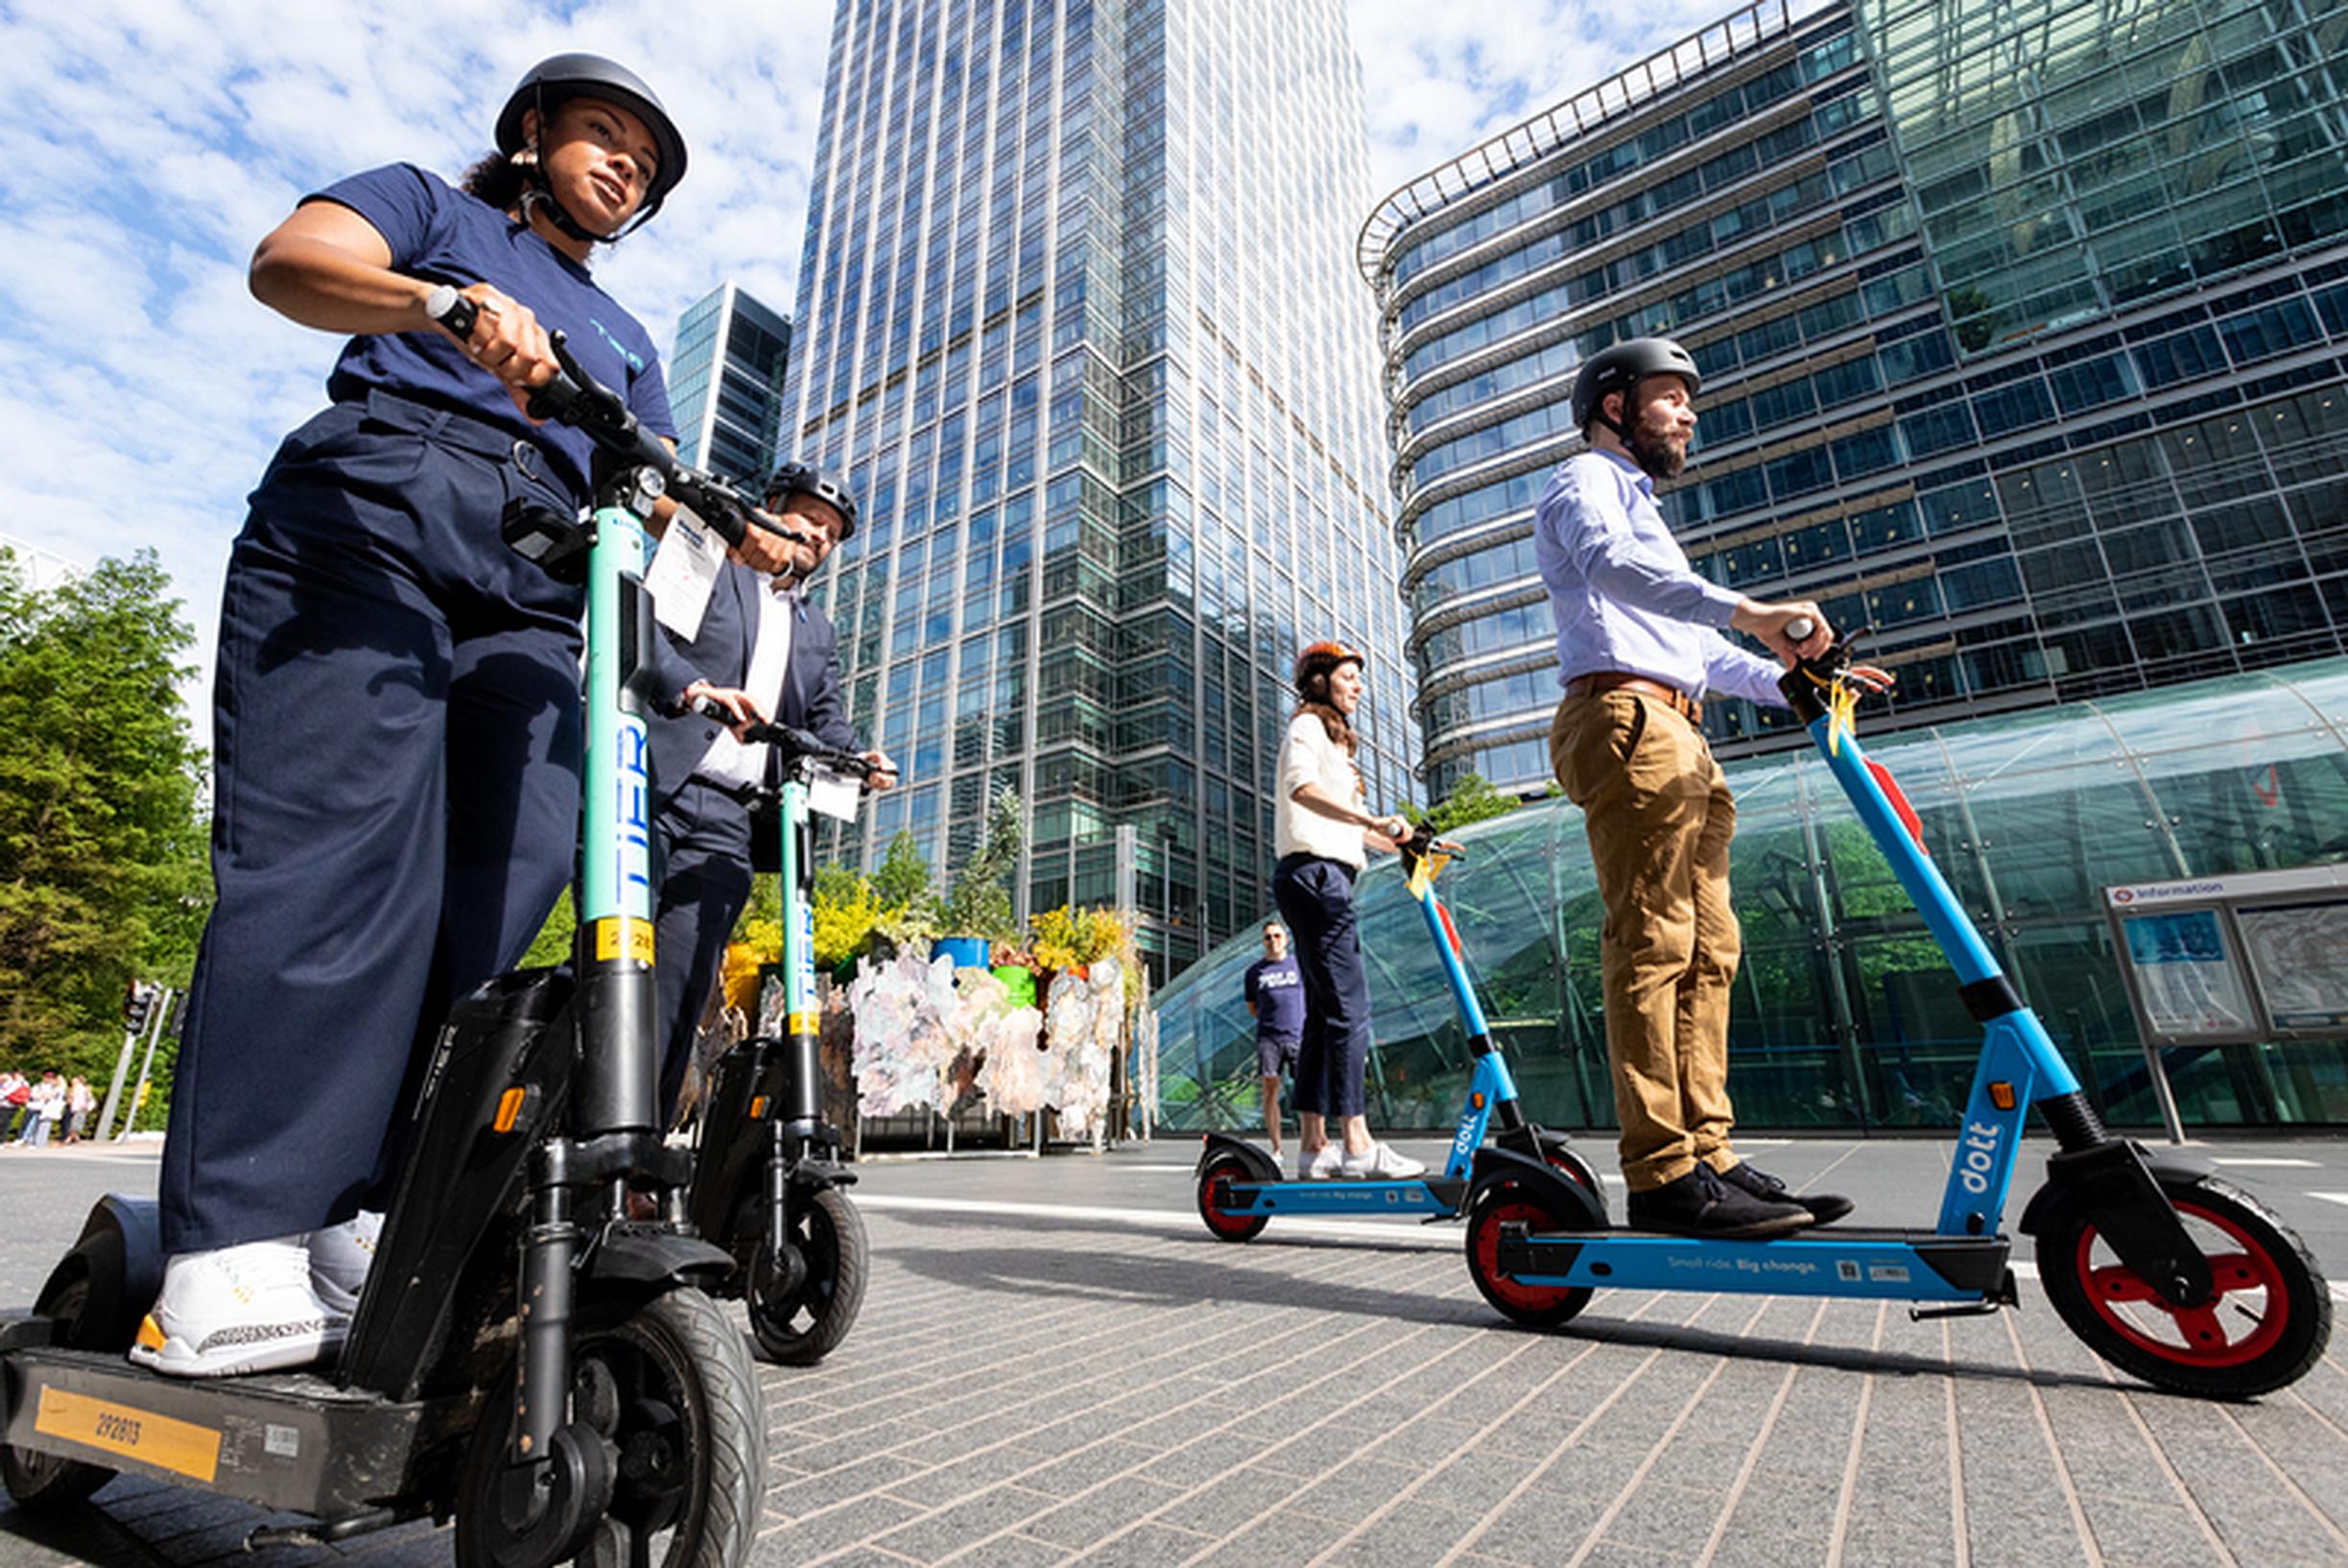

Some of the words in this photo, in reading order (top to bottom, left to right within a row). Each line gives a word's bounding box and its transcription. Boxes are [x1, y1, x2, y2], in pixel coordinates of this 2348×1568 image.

[617, 725, 649, 904] TIER
[2136, 883, 2224, 898] Information
[1959, 1121, 1999, 1194] dott
[1667, 1256, 1703, 1268] Small
[1736, 1258, 1761, 1273] Big
[1762, 1259, 1821, 1274] change.
